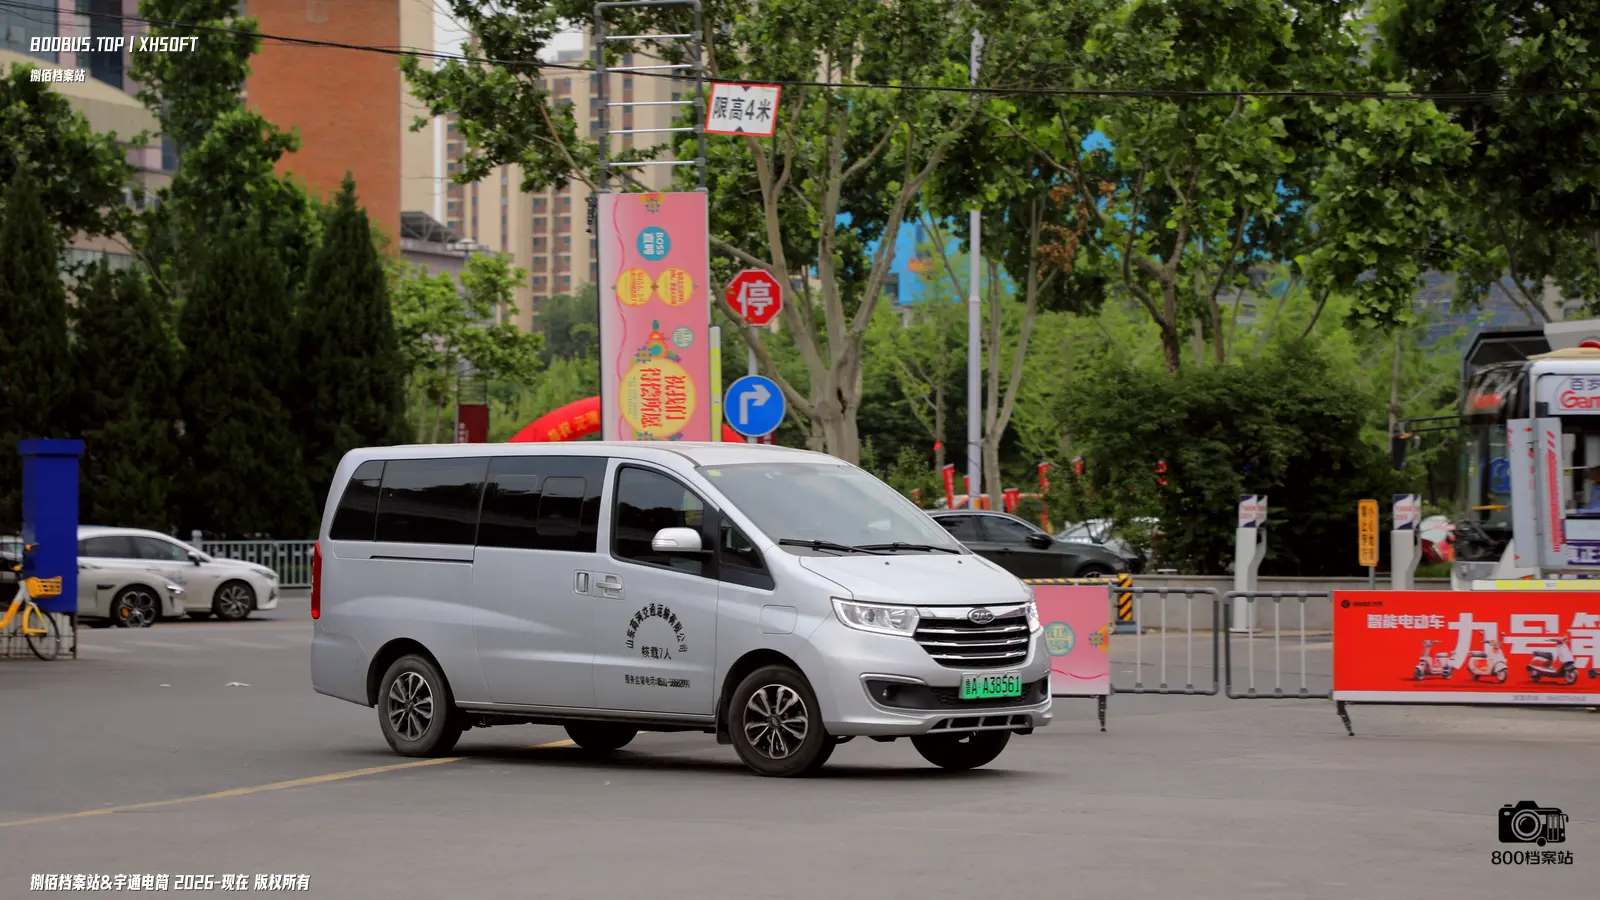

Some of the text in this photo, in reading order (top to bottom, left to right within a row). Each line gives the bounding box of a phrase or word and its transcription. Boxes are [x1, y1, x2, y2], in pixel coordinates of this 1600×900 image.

[712, 97, 771, 122] 限高4米
[643, 232, 655, 256] 直聘
[655, 232, 665, 256] BOSS
[736, 279, 773, 316] 停
[640, 368, 663, 429] 得偿所愿
[665, 375, 687, 421] 祝我们
[1367, 614, 1444, 629] 智能电动车
[641, 645, 672, 660] 核载7人
